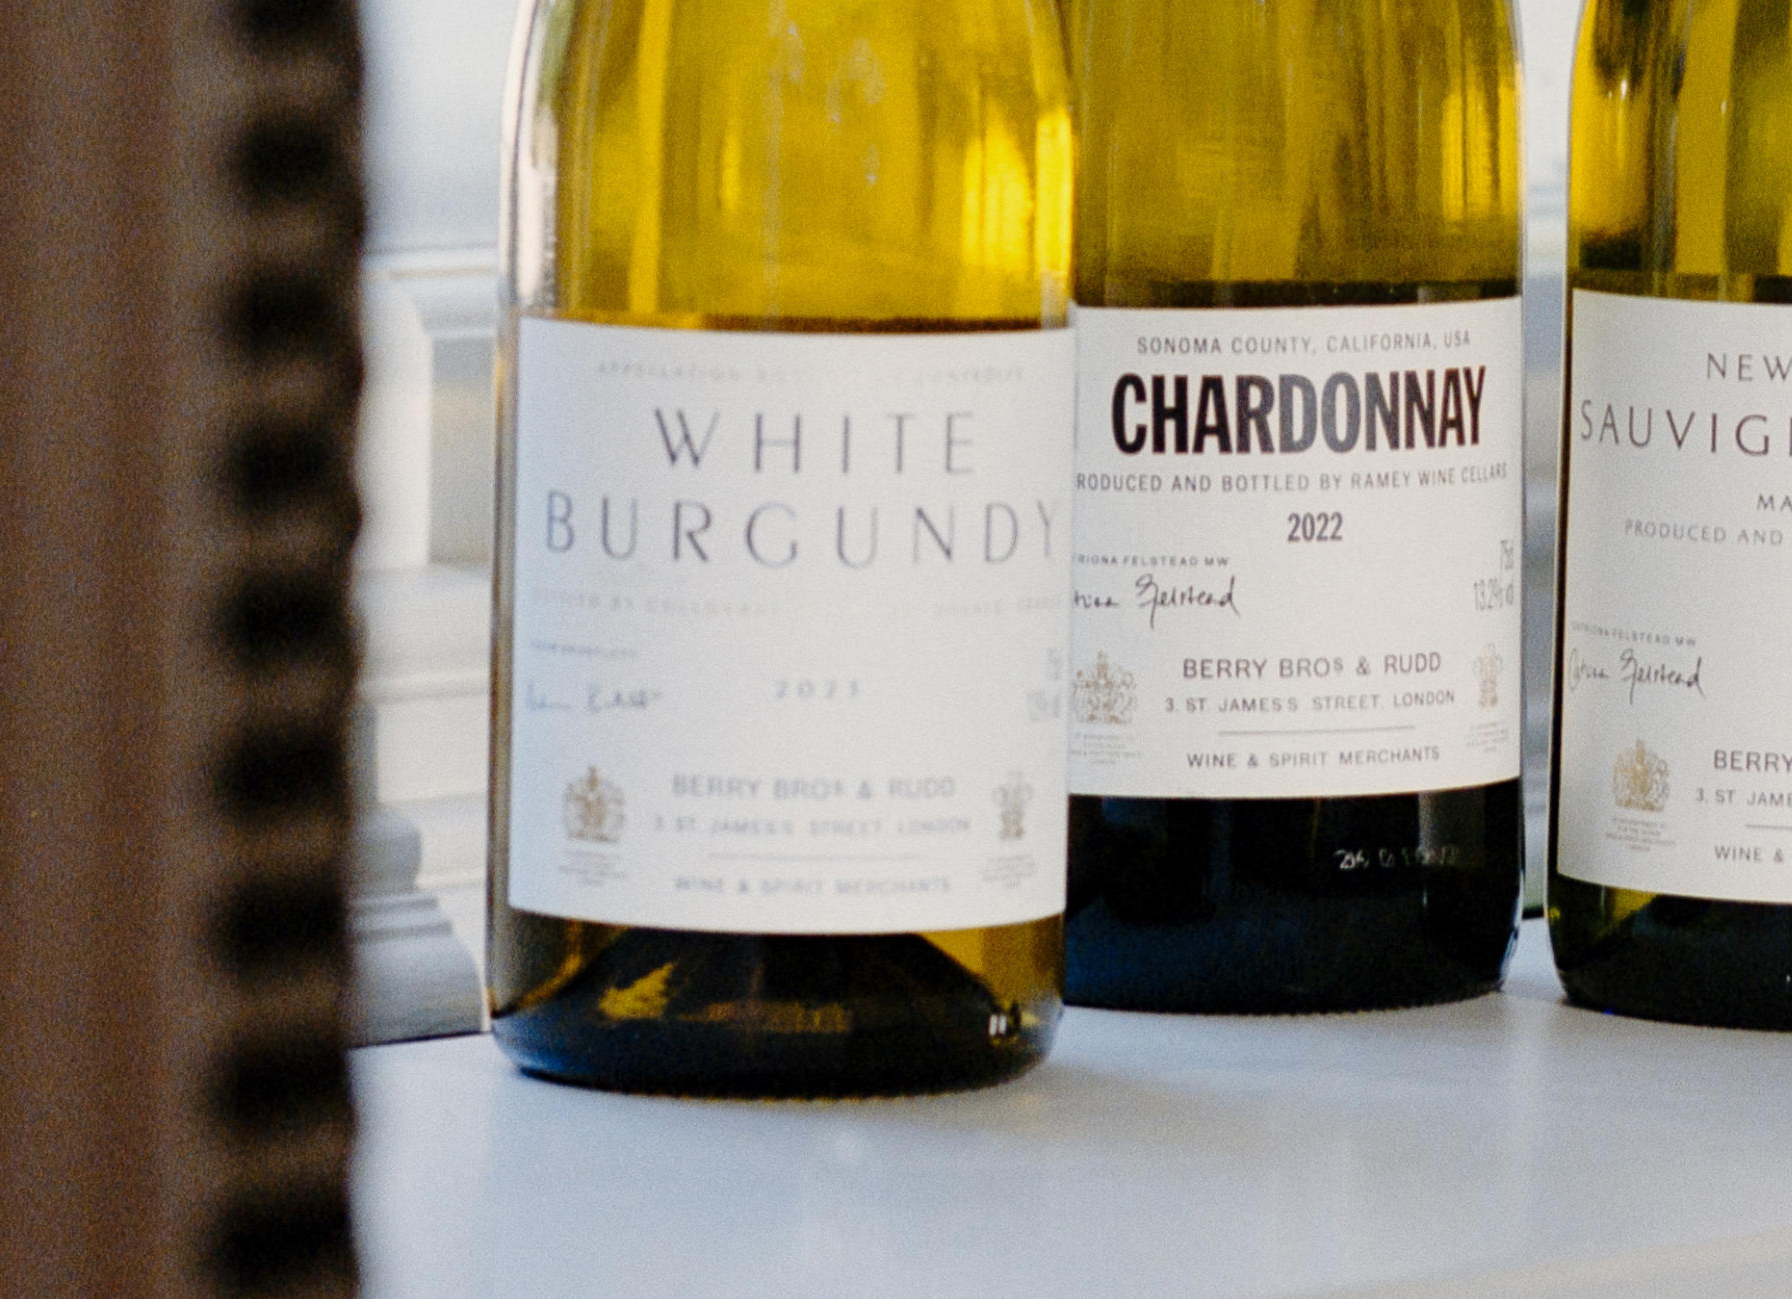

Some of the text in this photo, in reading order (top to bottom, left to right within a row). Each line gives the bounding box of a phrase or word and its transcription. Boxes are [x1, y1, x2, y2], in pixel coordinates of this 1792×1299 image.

[1137, 329, 1471, 357] SONOMA COUNTY, CALIFORNIA, USA
[1111, 365, 1486, 455] CHARDONNAY
[656, 408, 976, 474] WHITE
[1076, 460, 1508, 494] RODUCED AND BOTTLED BY RAMEY WINE CELLARS
[545, 488, 1058, 568] BURGUNDY
[1287, 511, 1343, 544] 2022
[1625, 519, 1726, 543] PRODUCED
[1737, 528, 1783, 546] AND
[1122, 555, 1199, 568] FELSTEAD
[1204, 556, 1230, 567] MW
[1612, 628, 1670, 646] FELSTEAD
[1675, 636, 1696, 648] MW
[1182, 657, 1267, 679] BERRY
[1355, 656, 1371, 676] &
[1384, 652, 1442, 674] RUDD
[1393, 689, 1455, 708] LONDON
[1187, 746, 1440, 768] WINE & SPIRIT MERCHANTS
[671, 773, 762, 797] BERRY
[857, 779, 873, 800] &
[888, 775, 957, 799] RUDD
[897, 816, 972, 836] LONDON
[1715, 846, 1763, 862] WINE
[1774, 848, 1785, 863] &
[675, 876, 725, 892] WINE
[761, 878, 823, 896] SPIRIT
[835, 877, 952, 896] MERCHANTS
